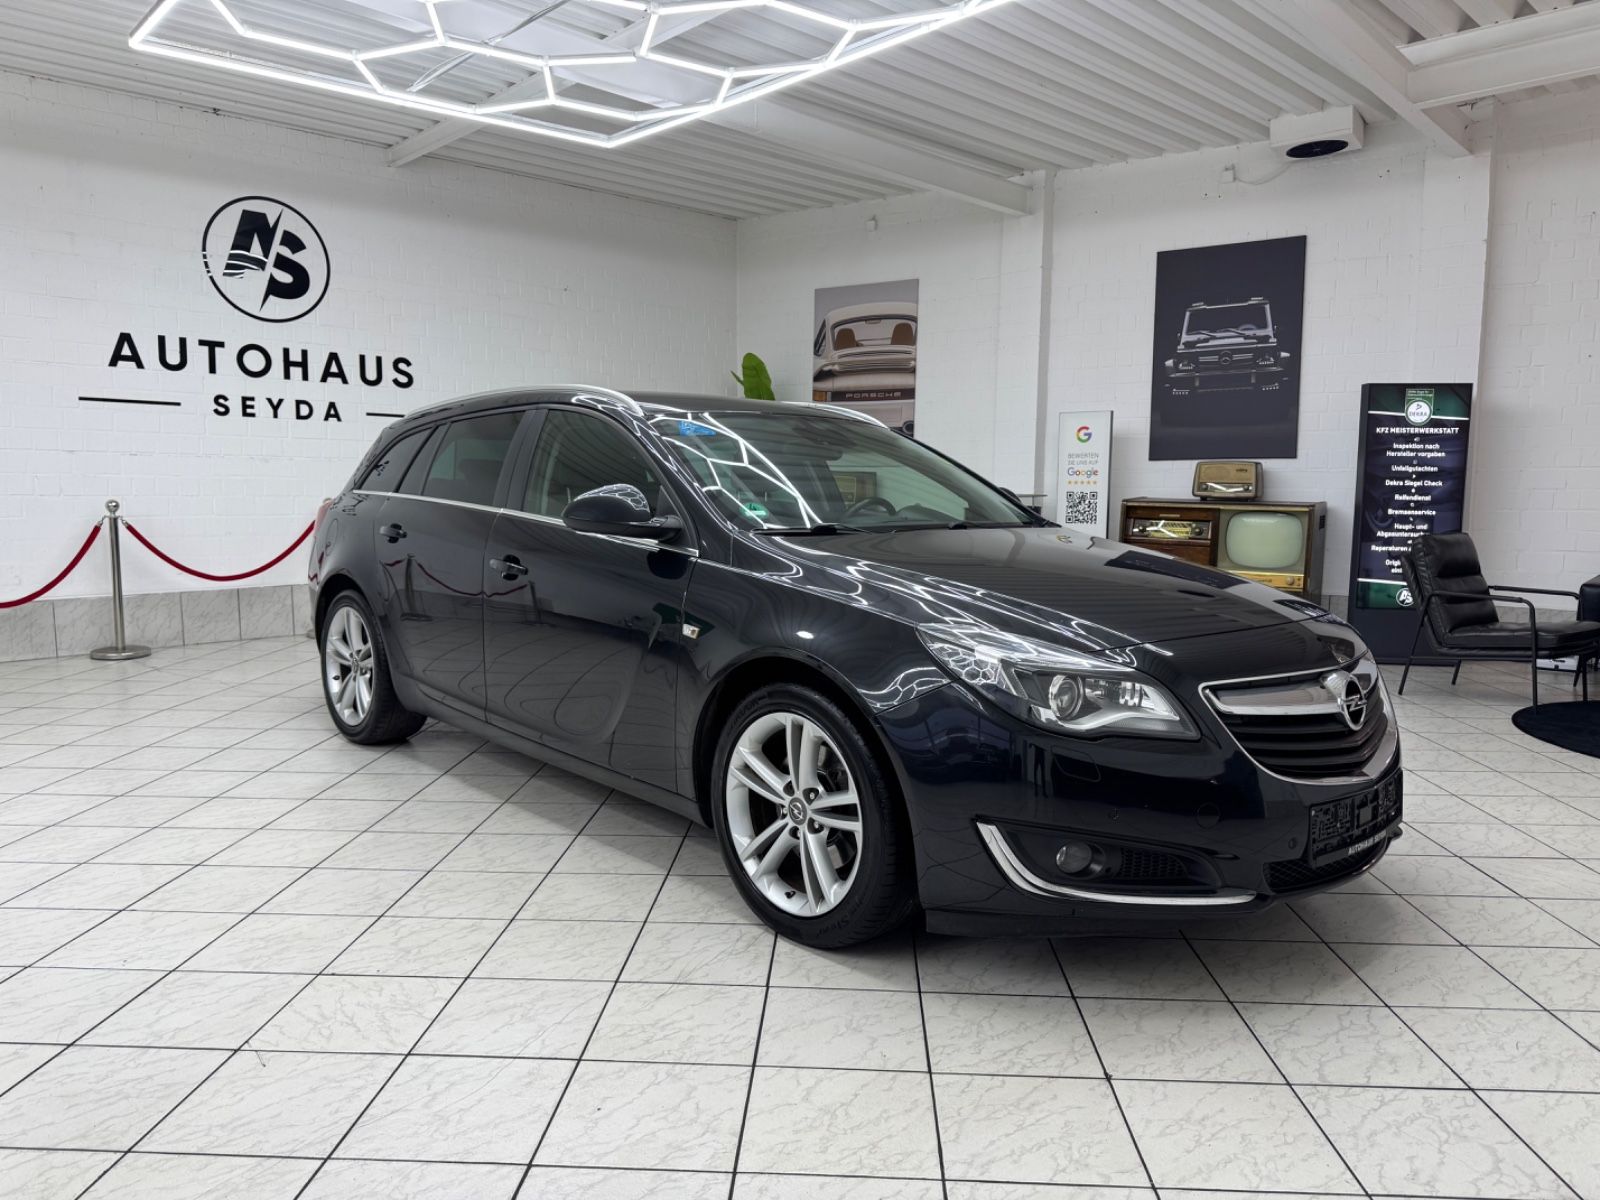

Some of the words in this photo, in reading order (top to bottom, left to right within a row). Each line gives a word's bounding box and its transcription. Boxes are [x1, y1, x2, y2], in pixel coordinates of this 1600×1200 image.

[108, 332, 414, 390] AUTOHAUS
[845, 391, 901, 399] PORSCHE
[213, 394, 342, 422] SEYDA
[1067, 466, 1099, 479] Google
